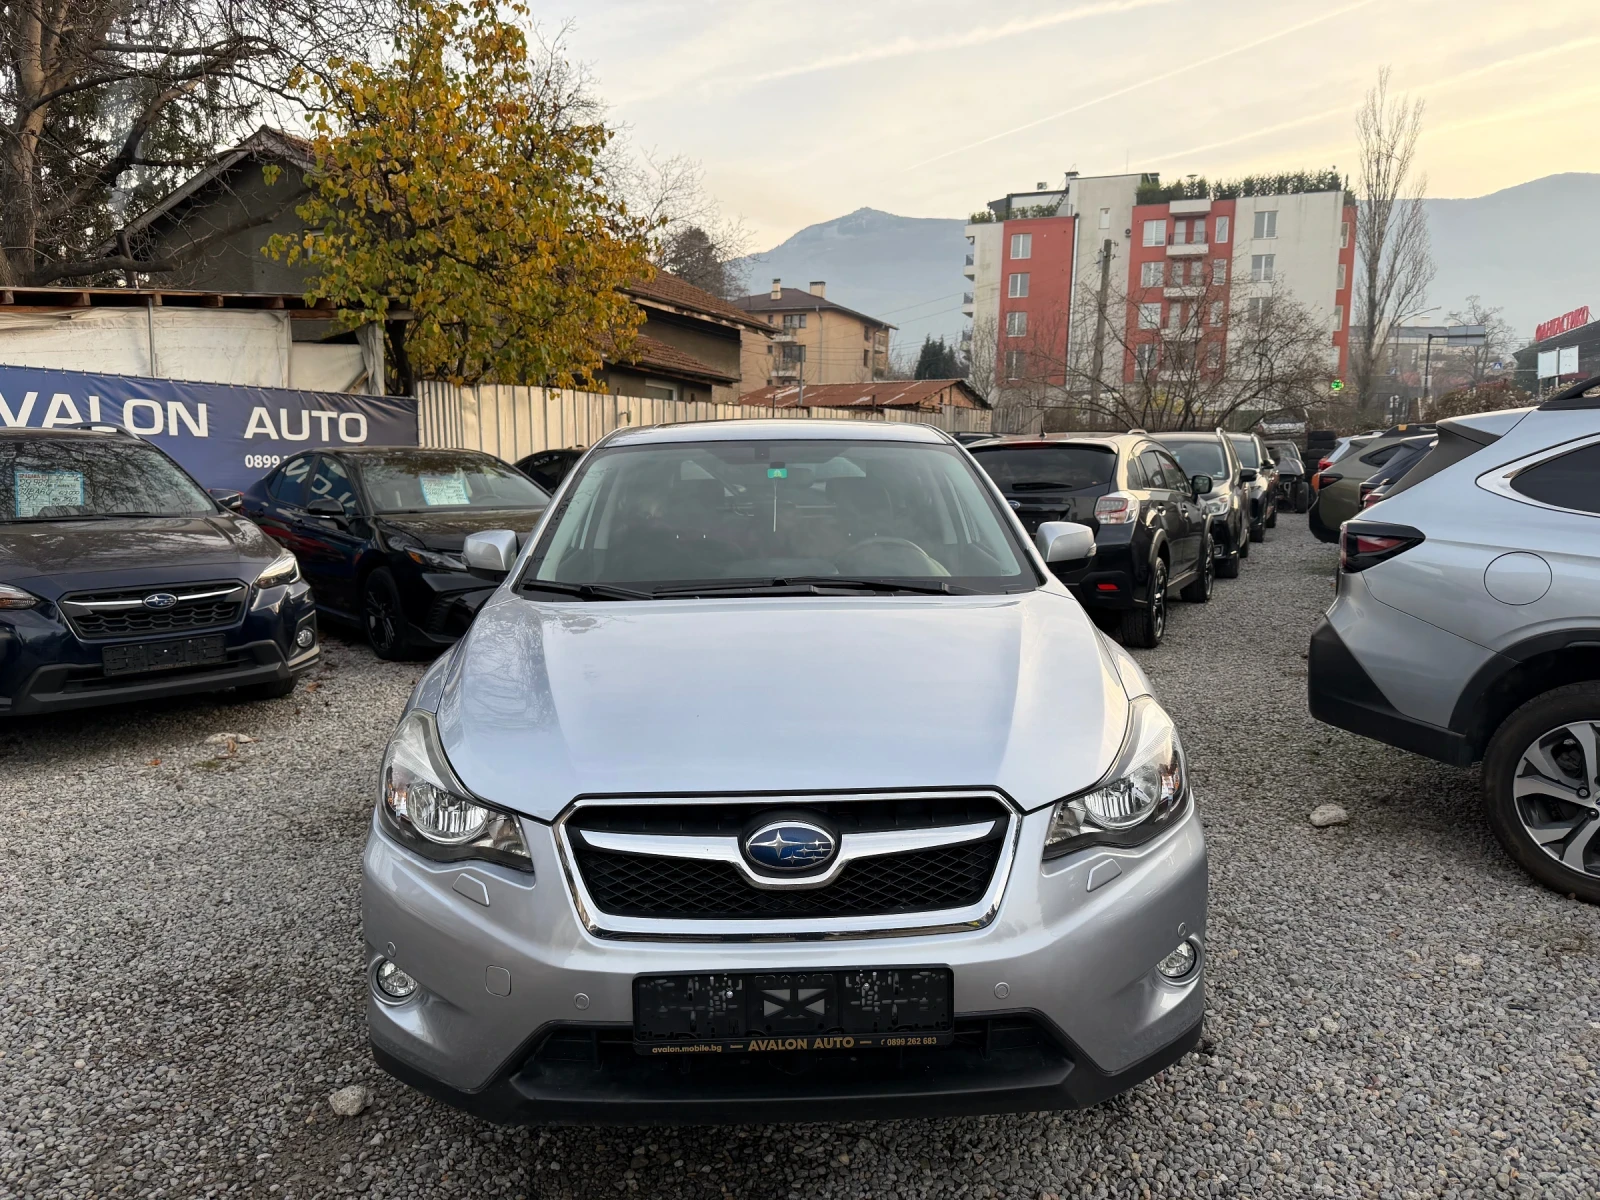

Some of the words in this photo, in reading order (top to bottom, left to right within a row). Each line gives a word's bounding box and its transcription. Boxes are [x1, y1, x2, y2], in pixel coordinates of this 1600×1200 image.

[243, 407, 368, 443] AUTO
[244, 454, 281, 469] 0899
[652, 1044, 722, 1054] avalon.mobile.bg
[748, 1038, 807, 1052] AVALON
[813, 1036, 855, 1049] AUTO
[886, 1038, 906, 1046] 0899
[907, 1037, 921, 1045] 262
[923, 1036, 937, 1045] 683
